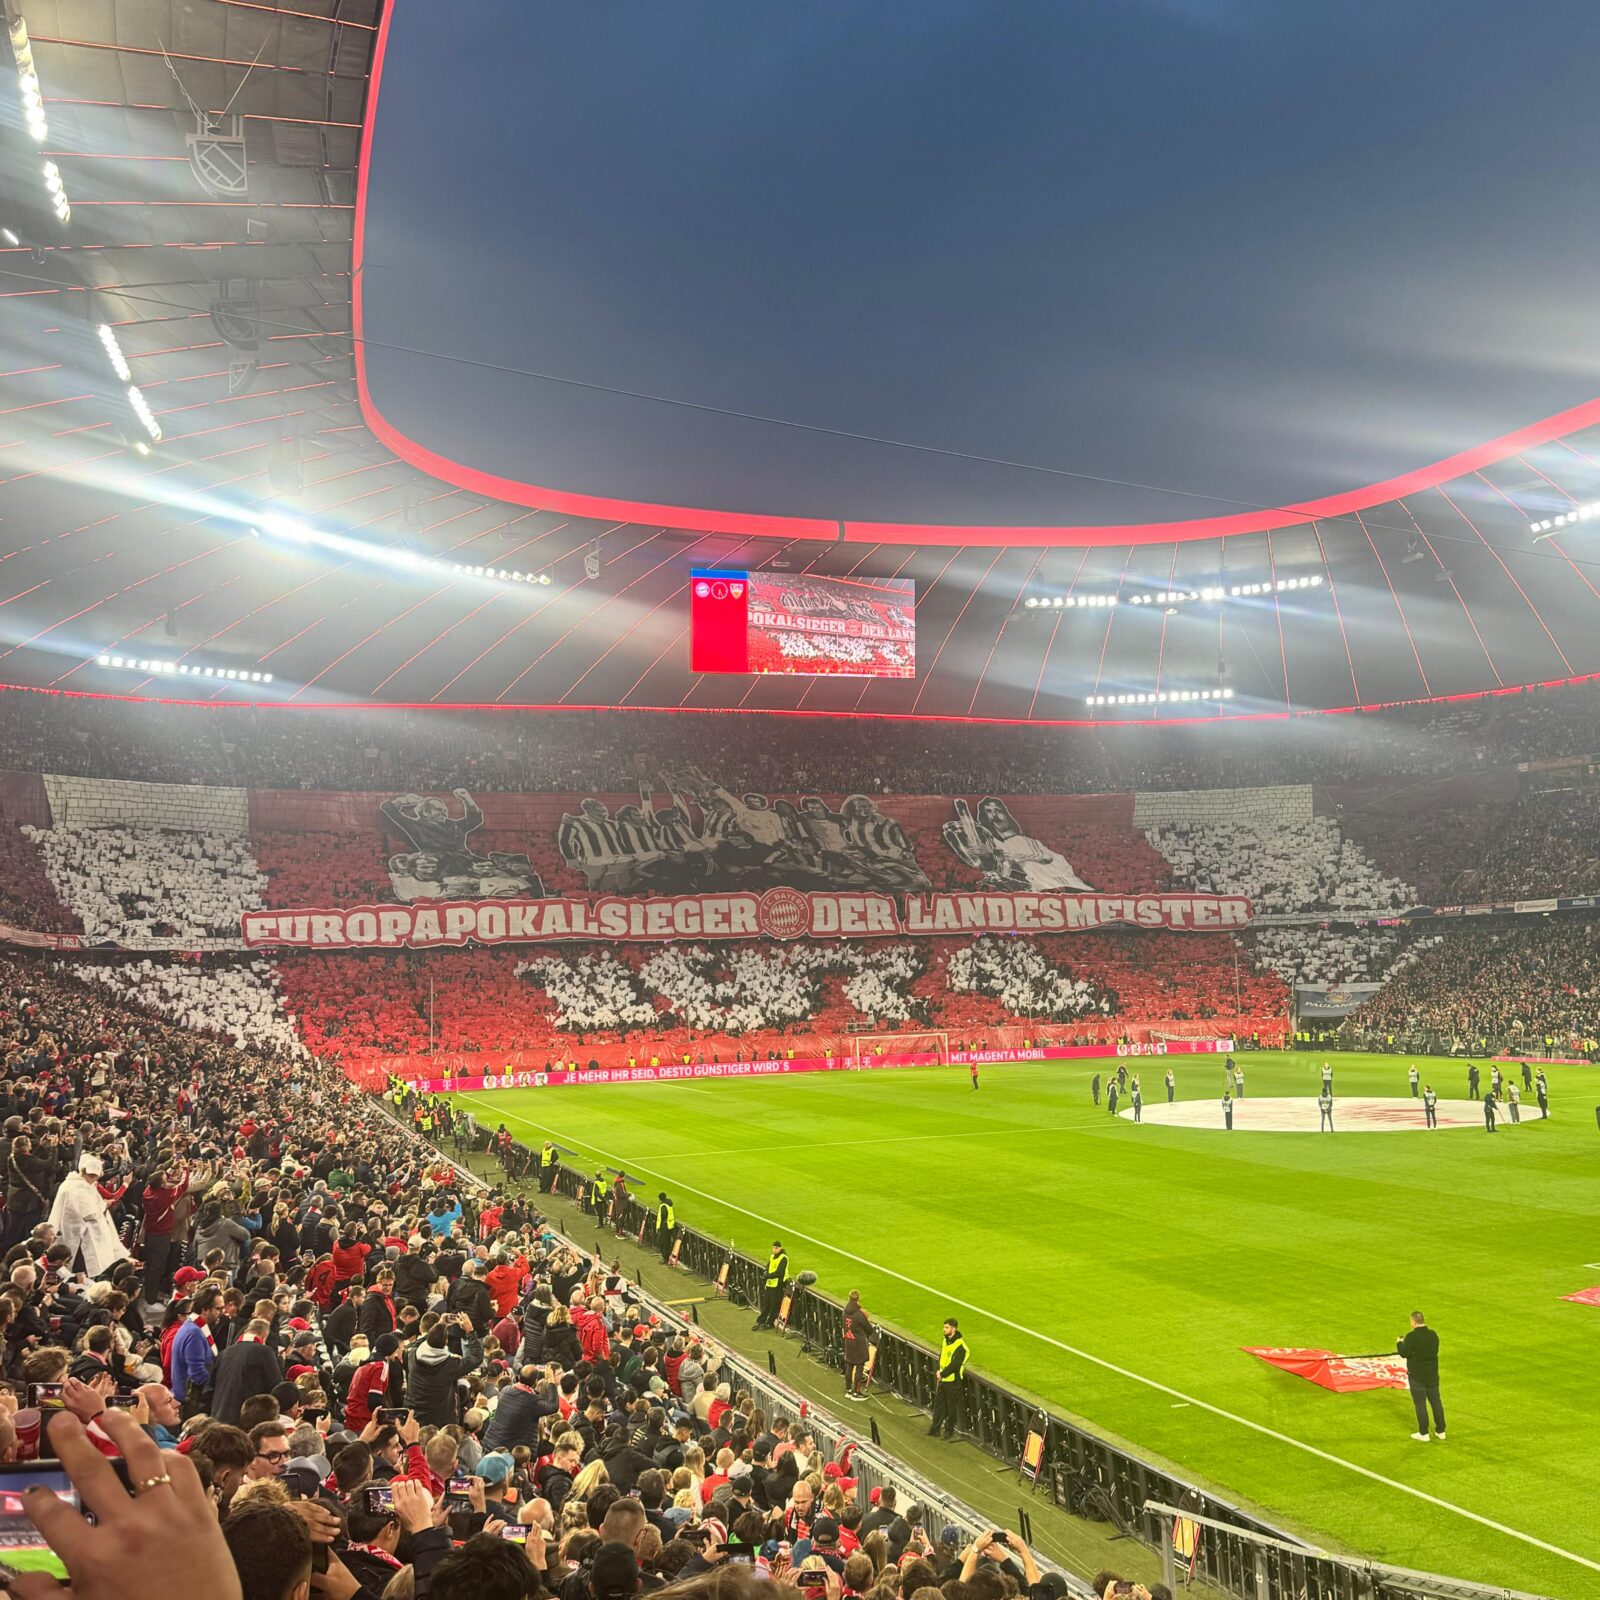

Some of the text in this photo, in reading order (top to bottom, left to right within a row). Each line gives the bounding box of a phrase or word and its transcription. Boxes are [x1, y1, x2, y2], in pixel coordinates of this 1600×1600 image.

[774, 893, 804, 910] BAYERN
[246, 896, 1249, 944] EUROPAPOKALSIEGER DER LANDESMEISTER
[951, 1050, 1046, 1063] MIT MAGENTA MOBIL
[563, 1072, 577, 1083] JE
[578, 1071, 609, 1082] MEHR
[611, 1069, 629, 1080] IHR
[631, 1067, 658, 1079] SEID,
[660, 1066, 693, 1077] DESTO
[694, 1063, 751, 1076] GÜNSTIGER
